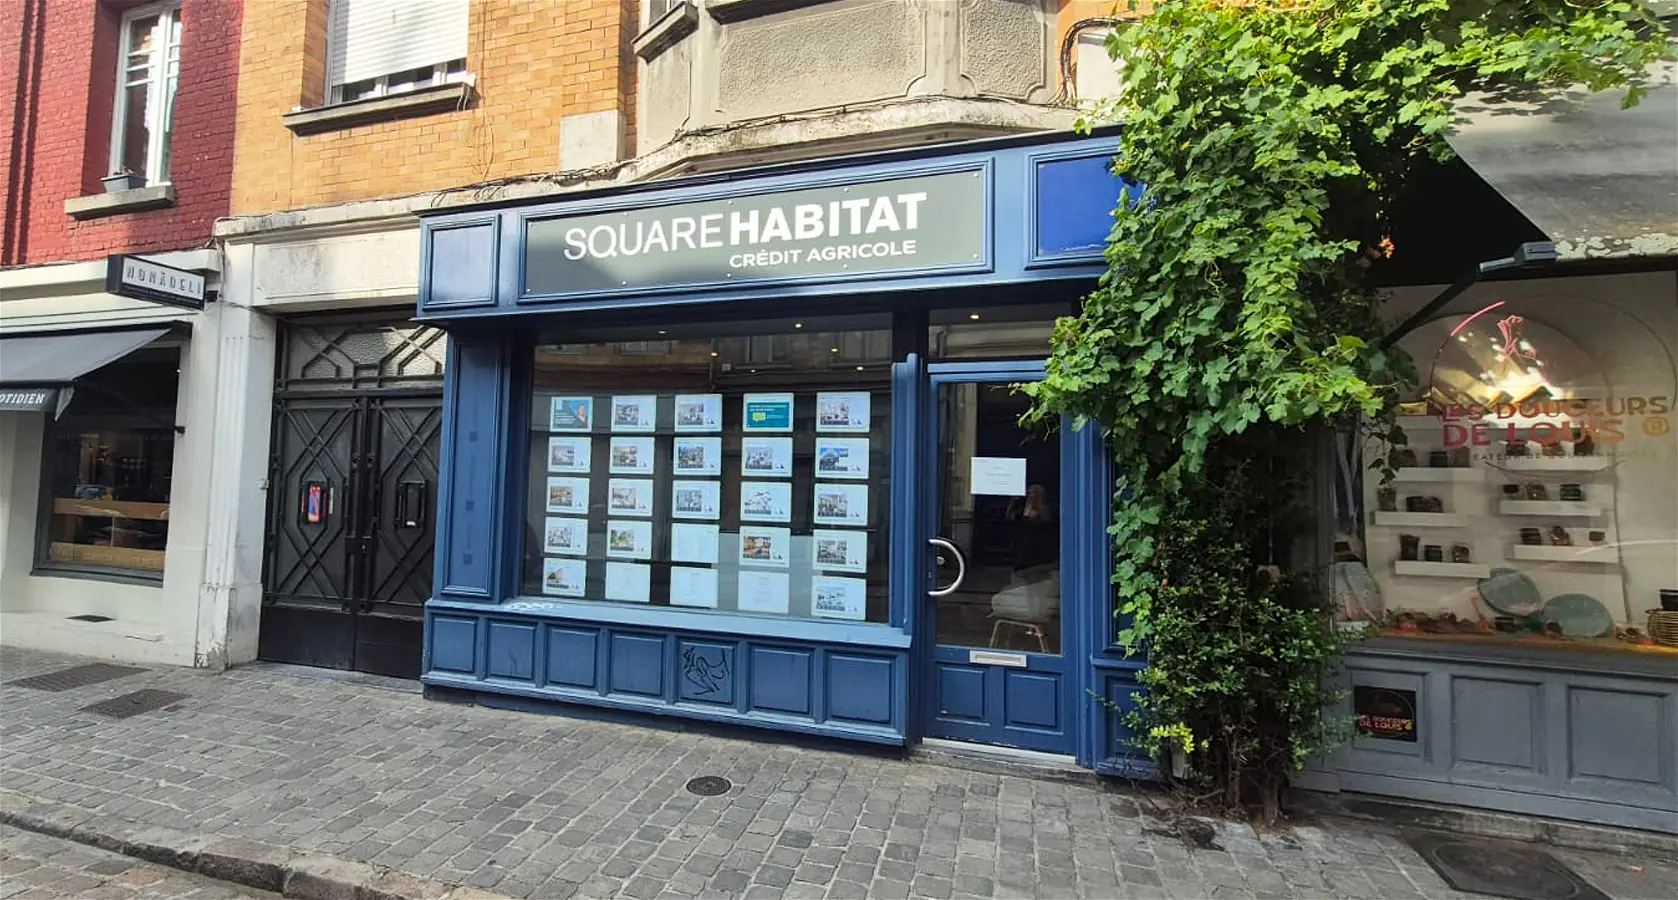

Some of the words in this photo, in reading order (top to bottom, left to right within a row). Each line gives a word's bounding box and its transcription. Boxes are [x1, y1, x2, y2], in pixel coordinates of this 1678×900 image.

[563, 213, 724, 260] SQUARE
[729, 192, 927, 246] HABITAT
[729, 249, 802, 268] CRÉDIT
[807, 240, 917, 262] AGRICOLE
[1495, 395, 1668, 419] DOUCEURS
[1443, 423, 1491, 448] DE
[1506, 418, 1625, 447] LOUIS
